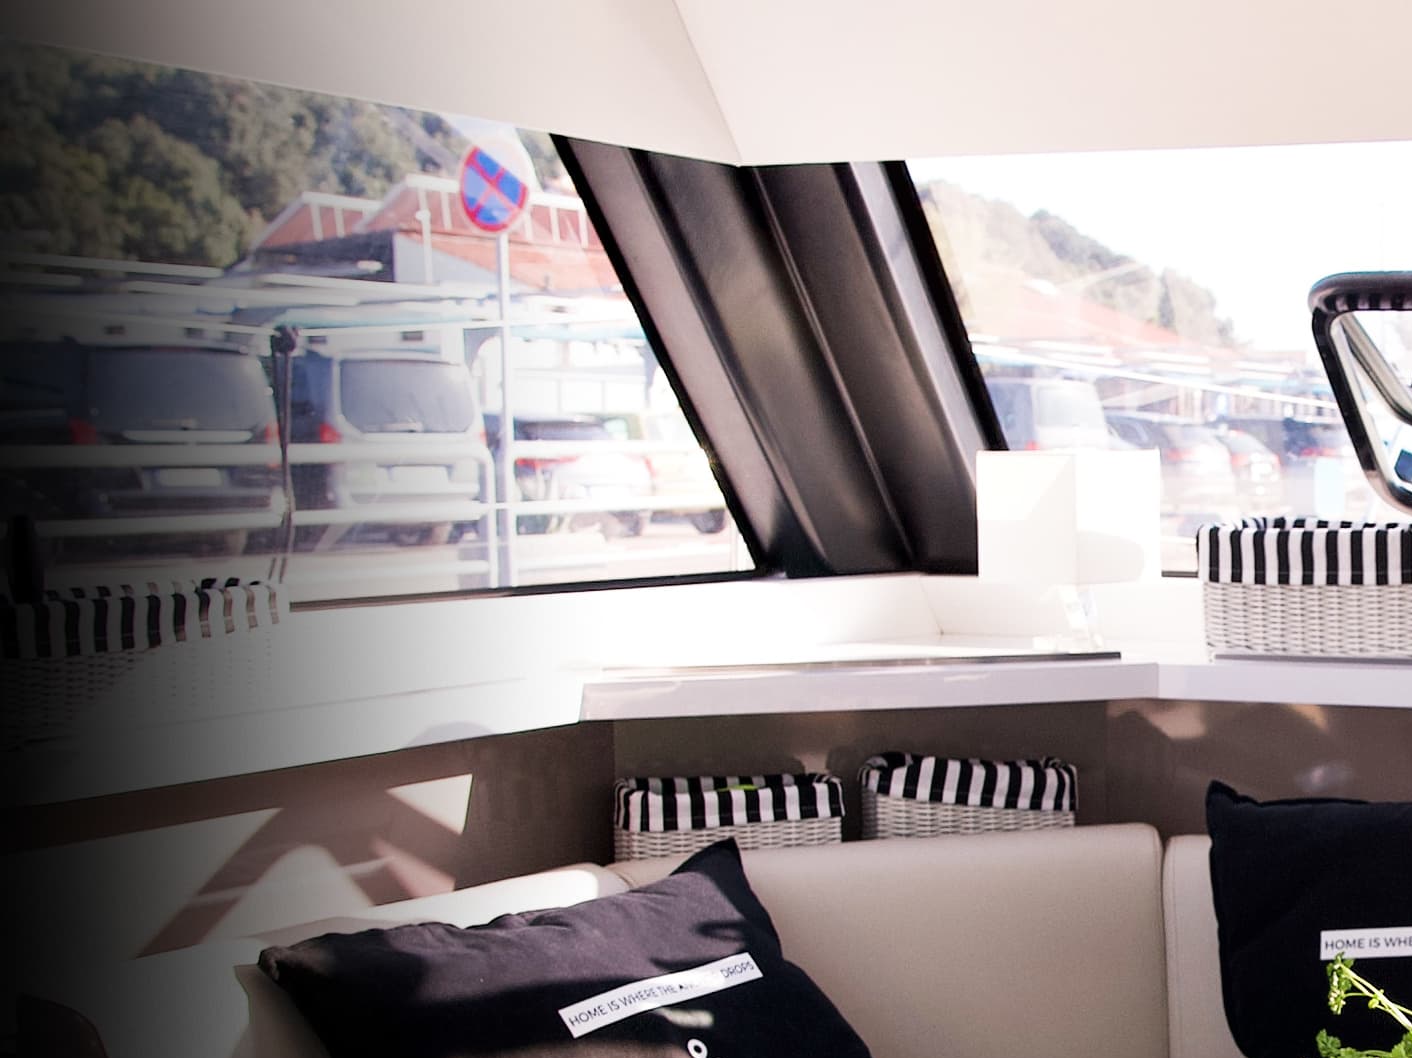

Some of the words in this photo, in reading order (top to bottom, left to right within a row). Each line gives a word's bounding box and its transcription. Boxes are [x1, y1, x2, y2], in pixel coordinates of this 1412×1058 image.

[1324, 938, 1366, 951] HOME
[1369, 937, 1381, 949] IS
[568, 1004, 608, 1027] HOME
[607, 1000, 620, 1012] IS
[619, 987, 659, 1007] WHERE
[657, 984, 678, 997] THE
[719, 961, 755, 979] DROPS
